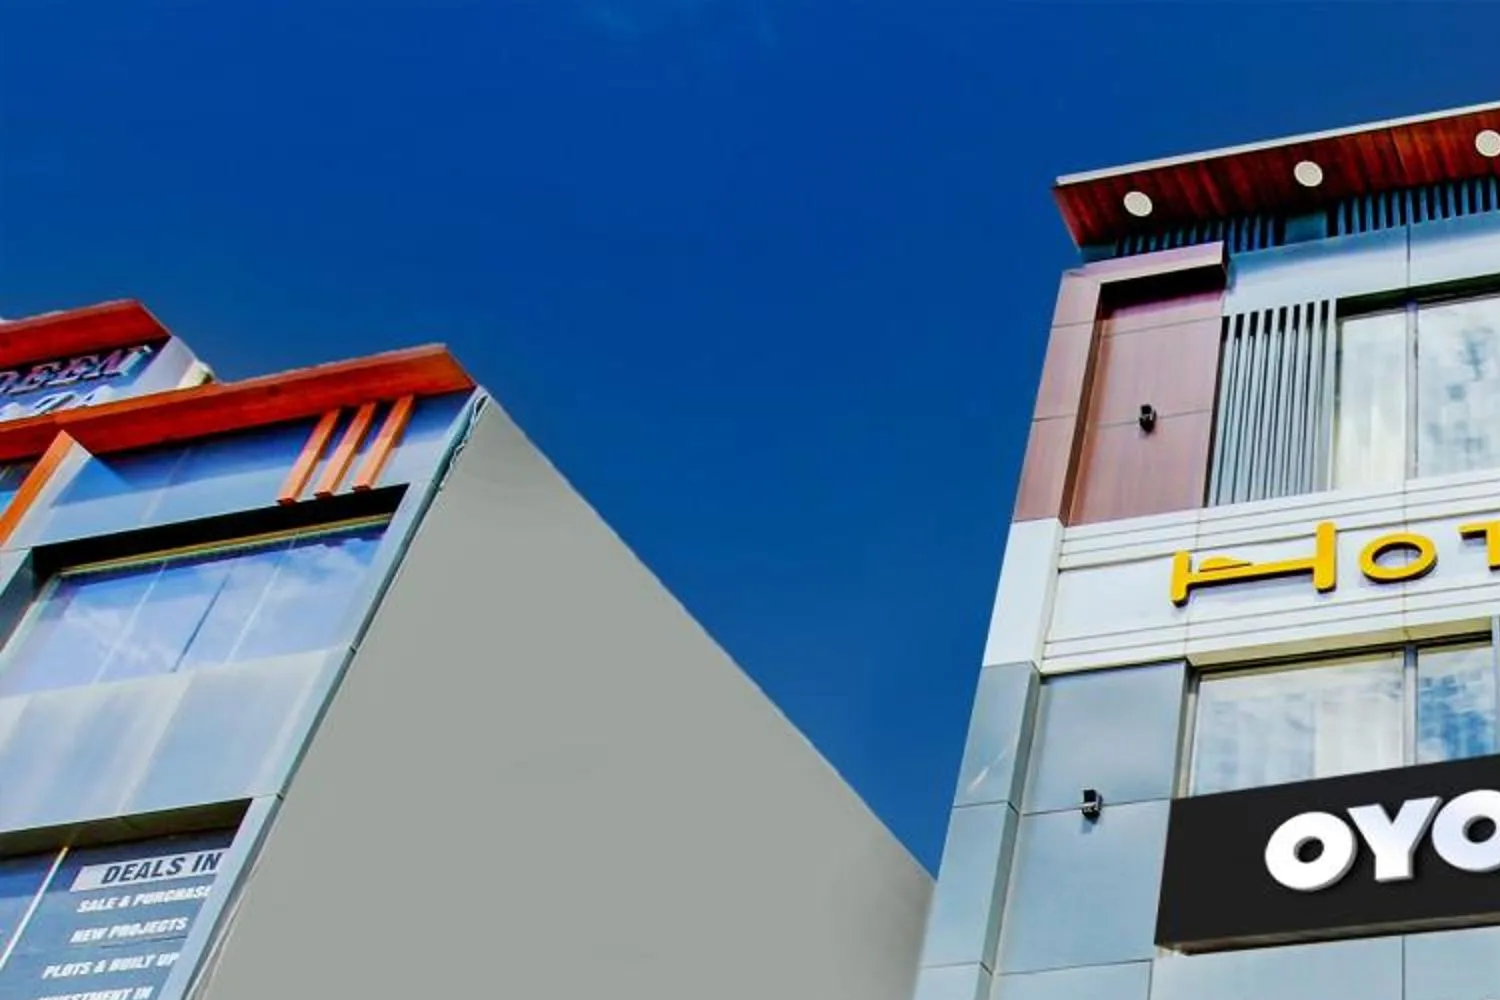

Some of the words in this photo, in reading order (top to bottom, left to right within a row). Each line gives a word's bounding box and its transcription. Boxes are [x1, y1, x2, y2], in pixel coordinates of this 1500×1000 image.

[101, 856, 186, 884] DEALS
[192, 852, 223, 874] IN
[77, 896, 118, 913] SALE
[69, 926, 110, 943] NEW
[107, 917, 189, 940] PROJECTS
[42, 960, 93, 980] PLOTS
[108, 955, 157, 973] BUILT
[156, 952, 181, 968] UP
[132, 985, 154, 1000] IN
